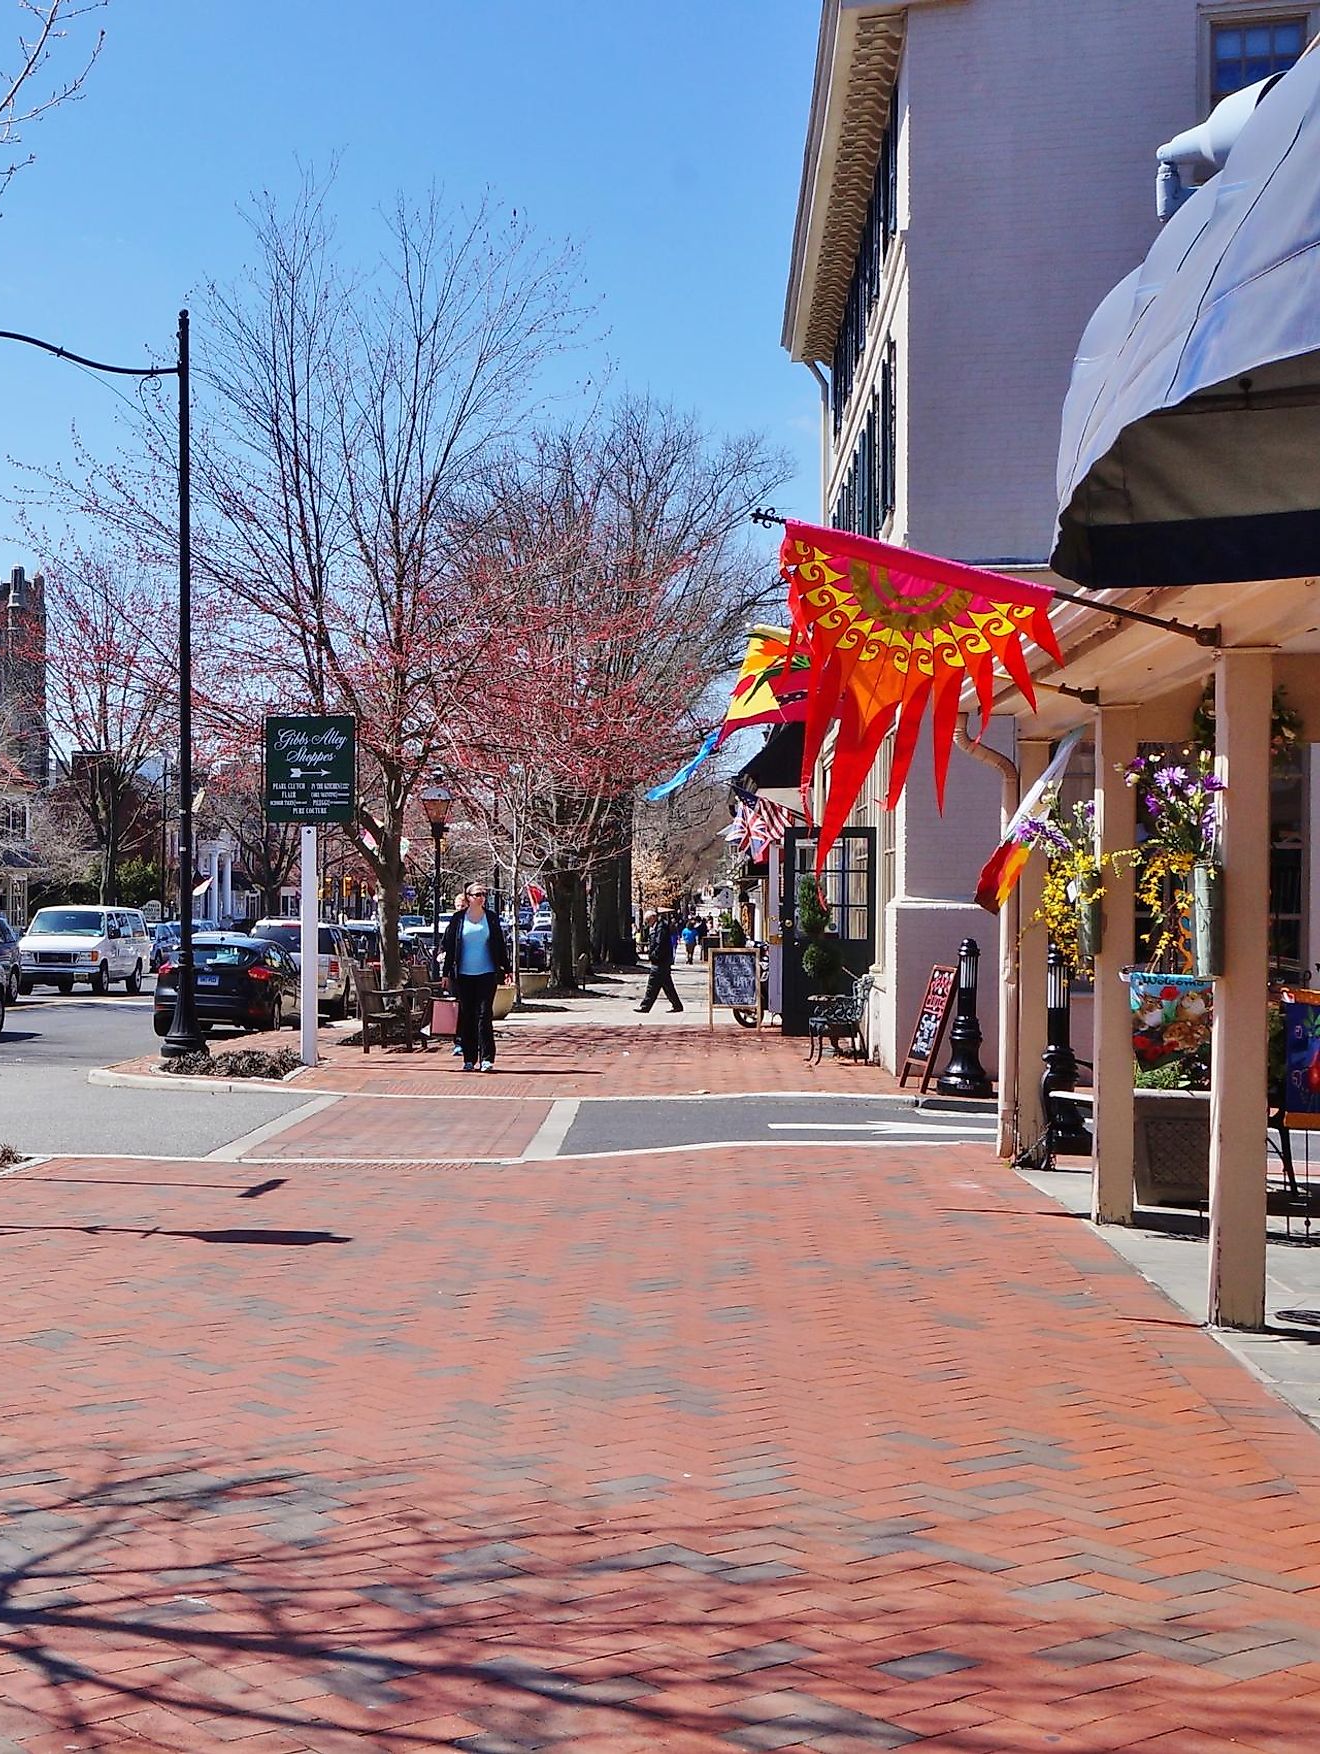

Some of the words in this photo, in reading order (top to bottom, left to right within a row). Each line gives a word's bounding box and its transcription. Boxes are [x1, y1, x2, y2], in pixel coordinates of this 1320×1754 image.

[274, 728, 309, 751] Gibbs
[311, 727, 348, 750] Alley
[286, 745, 335, 767] Shoppes
[733, 976, 755, 988] HAPPY
[1141, 974, 1205, 987] Welcome
